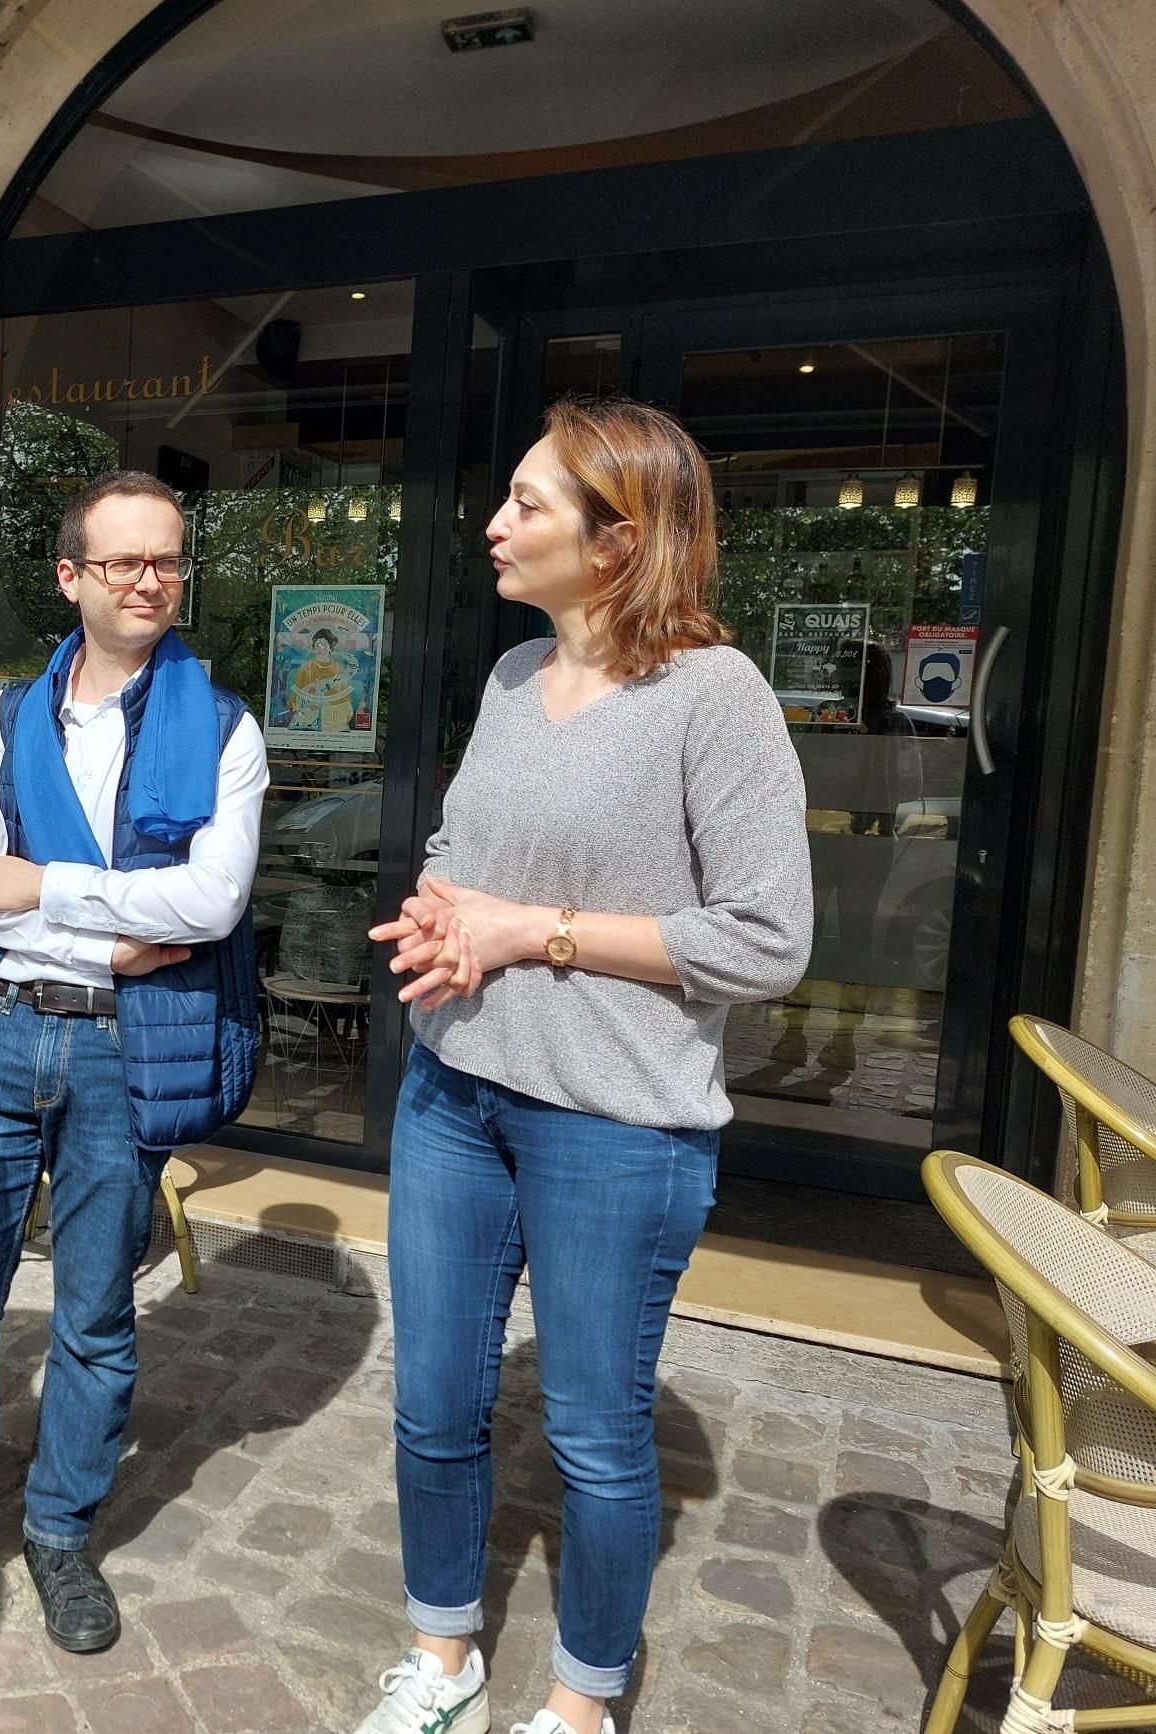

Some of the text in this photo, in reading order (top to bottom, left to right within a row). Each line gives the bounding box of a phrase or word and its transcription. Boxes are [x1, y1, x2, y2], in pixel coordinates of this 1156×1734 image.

[259, 507, 366, 567] Bar
[286, 616, 298, 627] UN
[298, 605, 321, 620] TEMPS
[323, 604, 346, 617] POUR
[347, 610, 366, 628] ELLES
[804, 613, 861, 629] QUAIS
[796, 642, 830, 655] Happy
